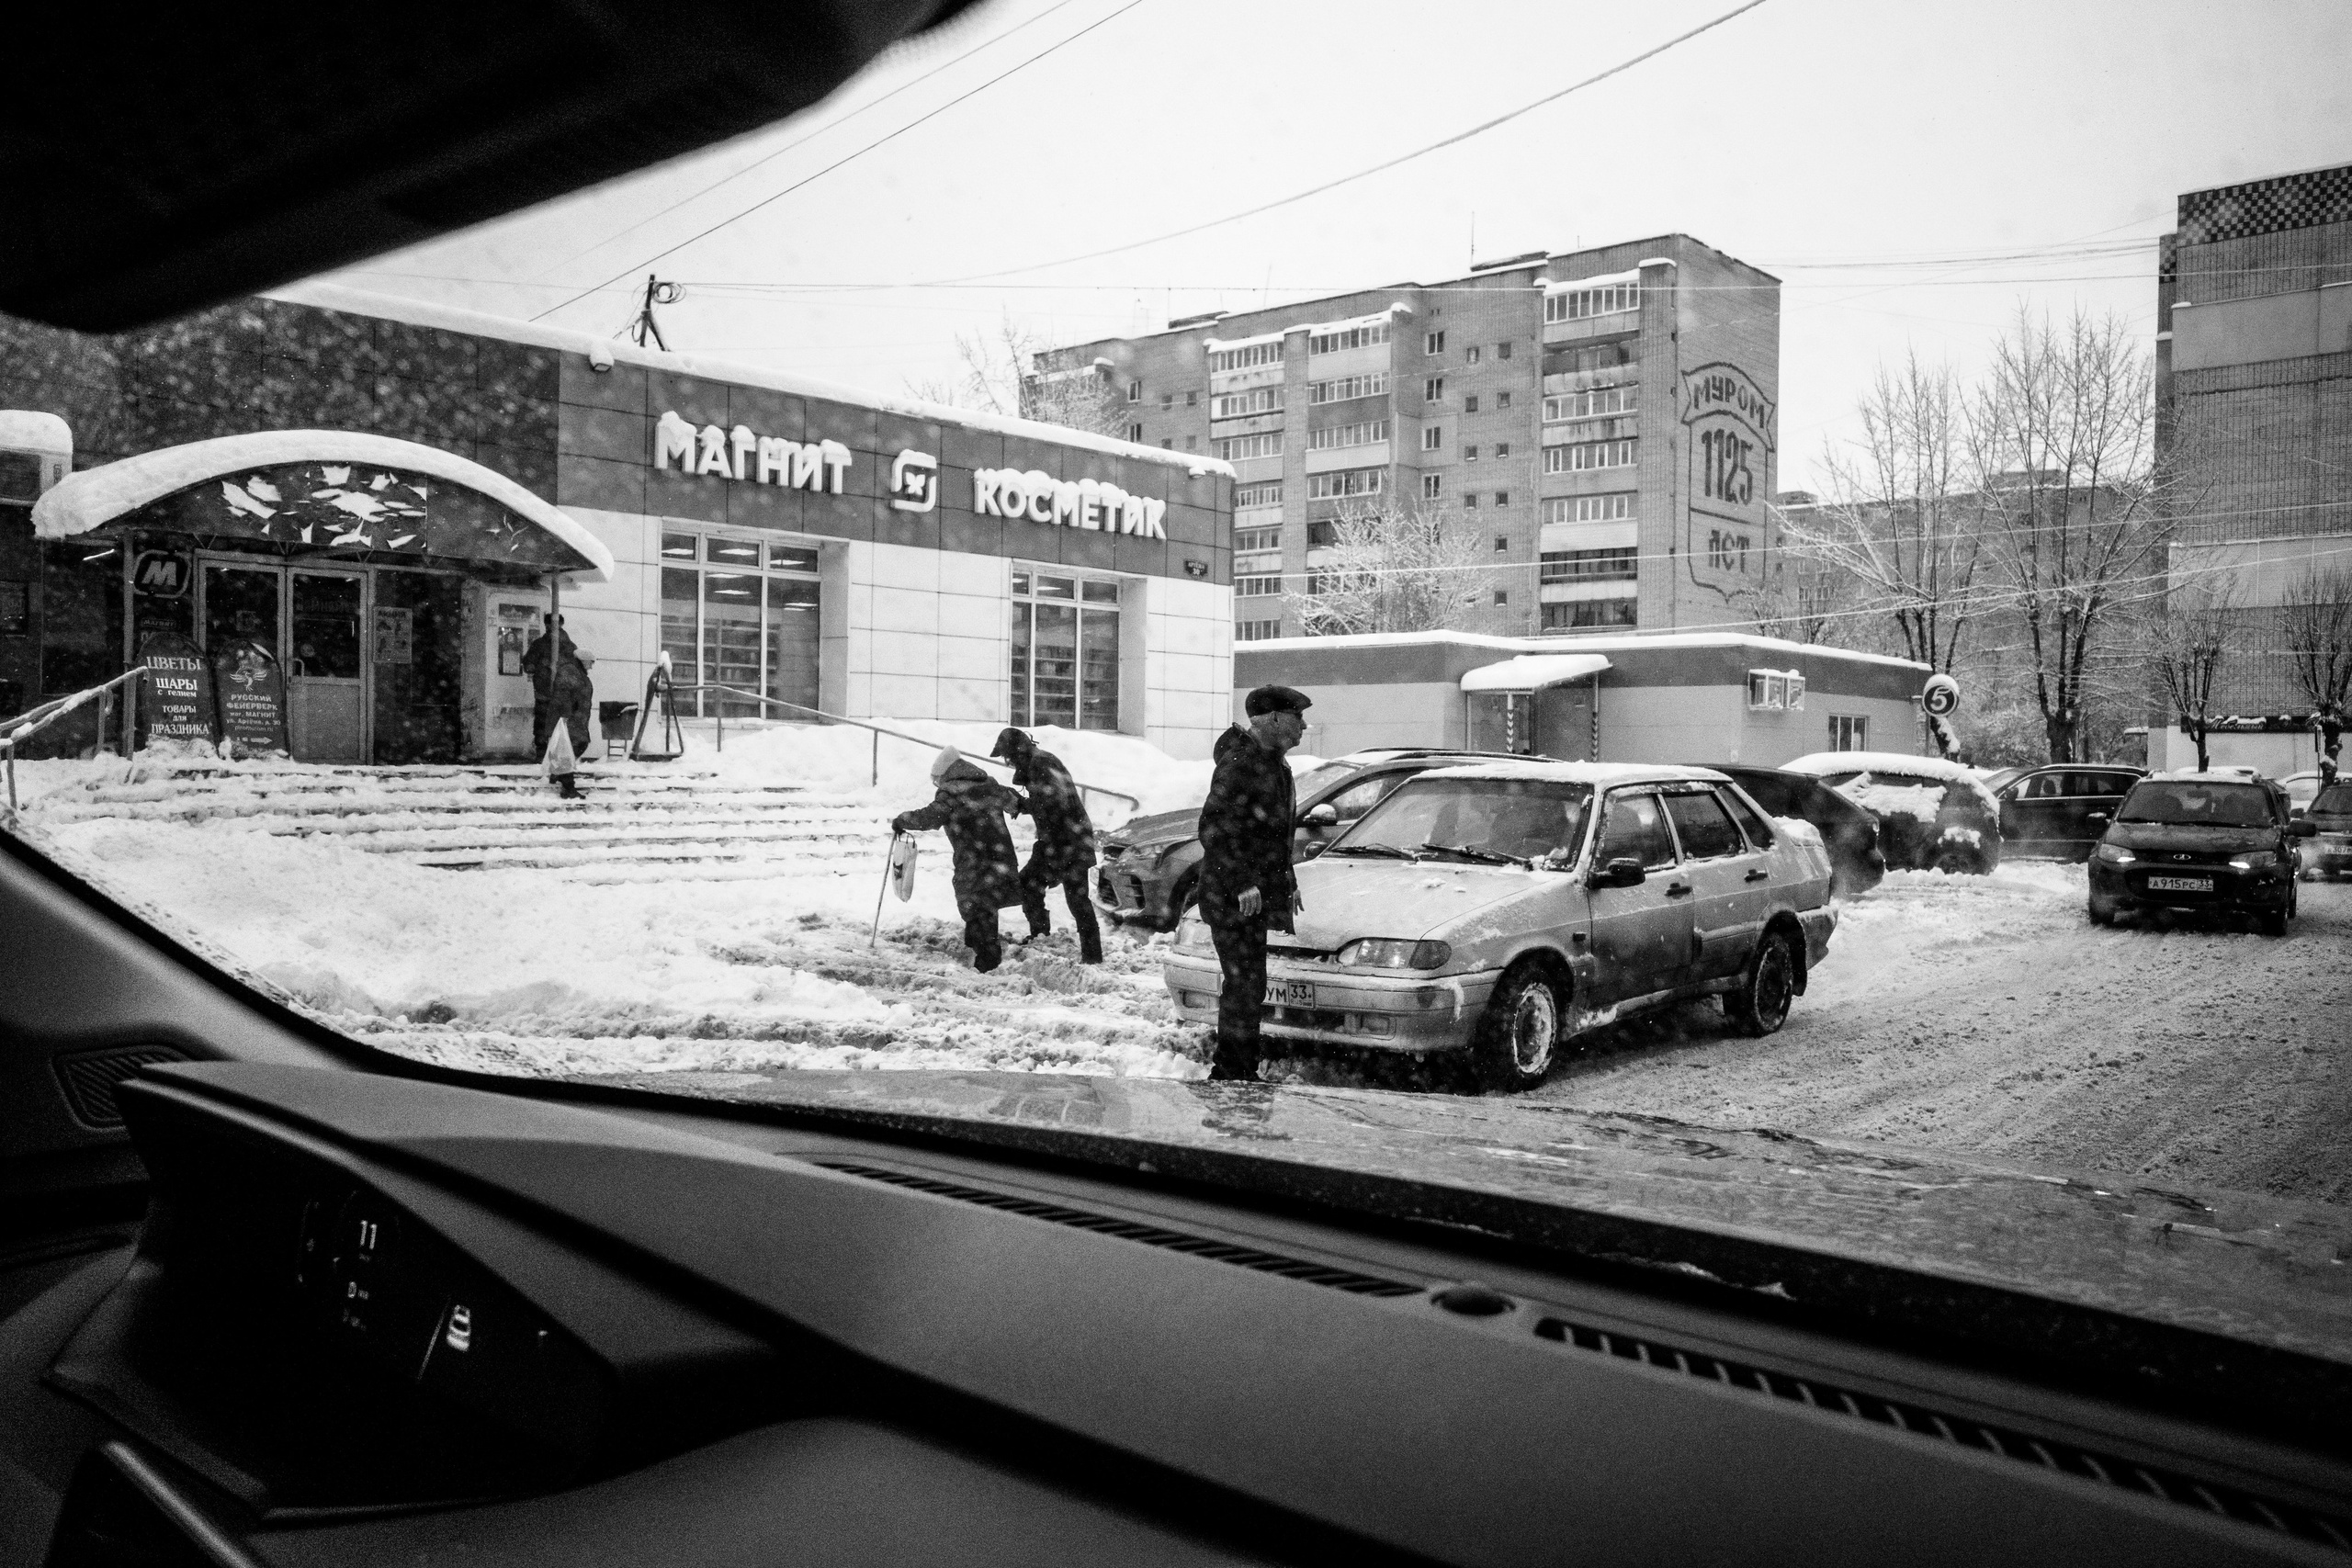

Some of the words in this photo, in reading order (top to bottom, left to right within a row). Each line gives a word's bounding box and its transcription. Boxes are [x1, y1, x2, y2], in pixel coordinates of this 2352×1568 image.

[1694, 375, 1765, 429] МУРОМ
[1702, 428, 1753, 505] 1125
[655, 418, 852, 494] МАГНИТ
[974, 468, 1167, 540] КОСМЕТИК
[146, 656, 201, 671] ЦВЕТЫ
[155, 677, 198, 691] ШАРЫ
[167, 689, 197, 698] гелием
[231, 694, 272, 702] РУССКИЙ
[1930, 686, 1951, 711] 5
[162, 705, 197, 714] ТОВАРЫ
[226, 702, 277, 711] ФЕЙЕРВЕРК
[151, 724, 209, 735] ПРАЗДНИКА
[1291, 984, 1307, 999] 33
